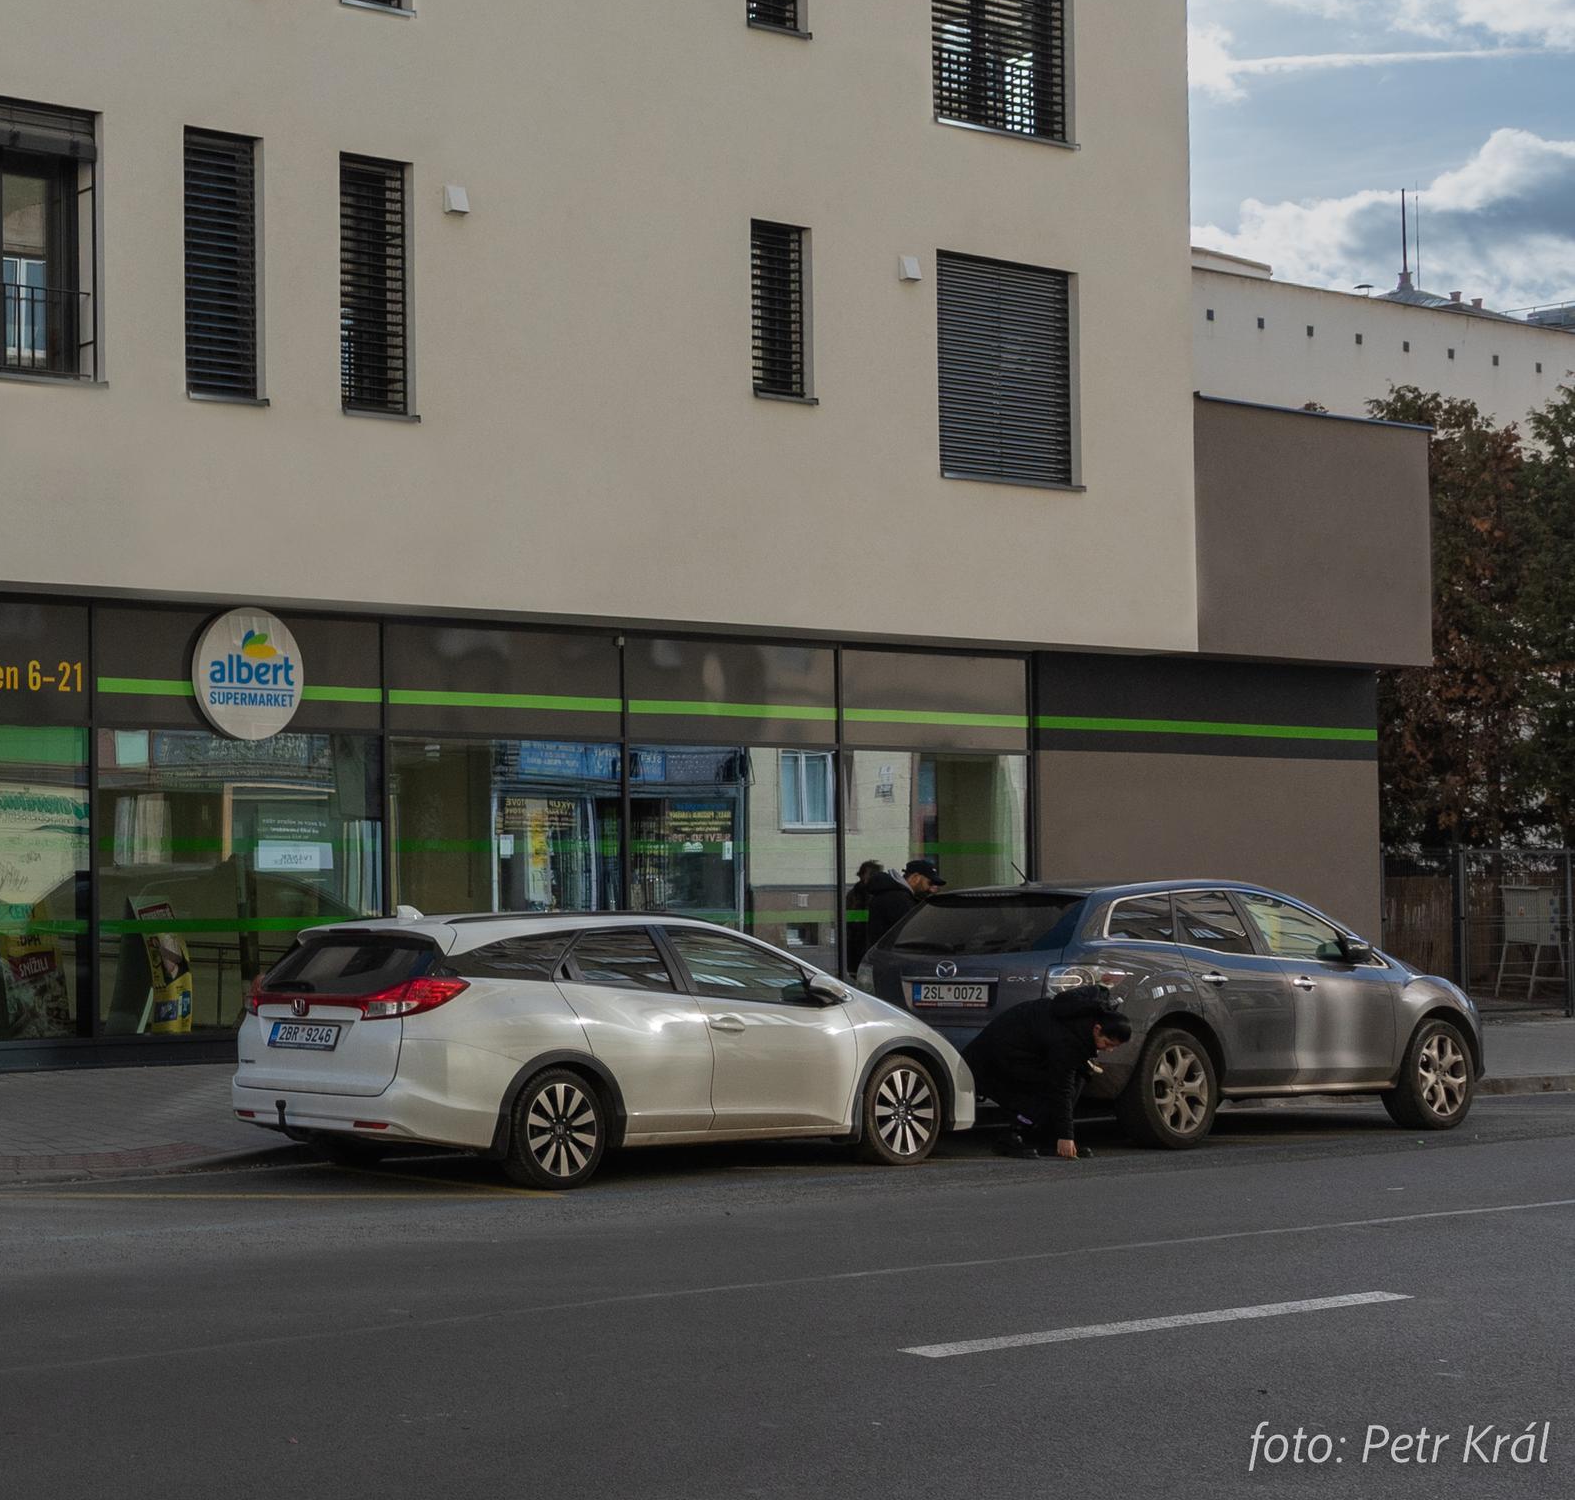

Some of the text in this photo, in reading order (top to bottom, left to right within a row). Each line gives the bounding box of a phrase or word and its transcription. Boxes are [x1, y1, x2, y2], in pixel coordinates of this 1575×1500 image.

[209, 654, 295, 686] albert
[209, 691, 294, 708] SUPERMARKET
[923, 986, 983, 1000] 2SL 0072
[279, 1026, 333, 1043] 2BR 9246
